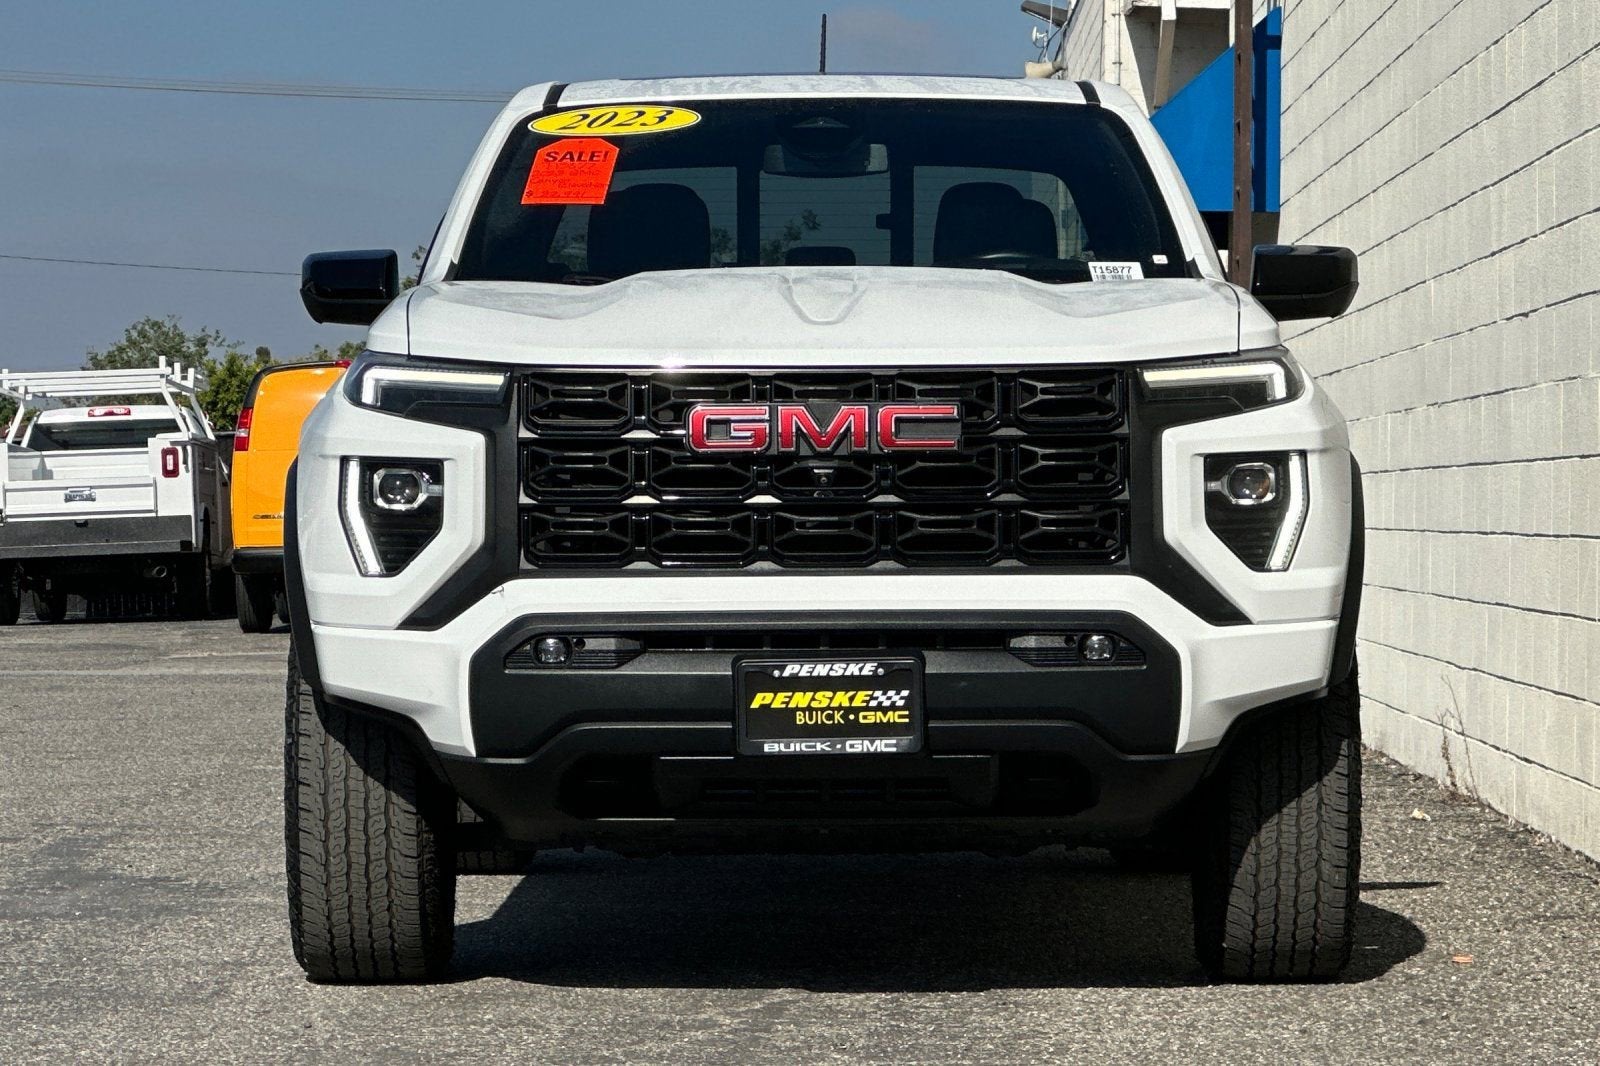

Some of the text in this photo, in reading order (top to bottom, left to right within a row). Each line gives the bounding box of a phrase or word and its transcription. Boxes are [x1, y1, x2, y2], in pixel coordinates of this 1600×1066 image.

[556, 109, 675, 131] 2023
[543, 150, 609, 163] SALE!
[1092, 265, 1132, 274] T15877
[688, 404, 960, 452] GMC
[782, 662, 878, 677] PENSKE
[750, 690, 874, 708] PENSKE
[796, 710, 910, 724] BUICK GMC
[763, 740, 897, 752] BUICK GMC
